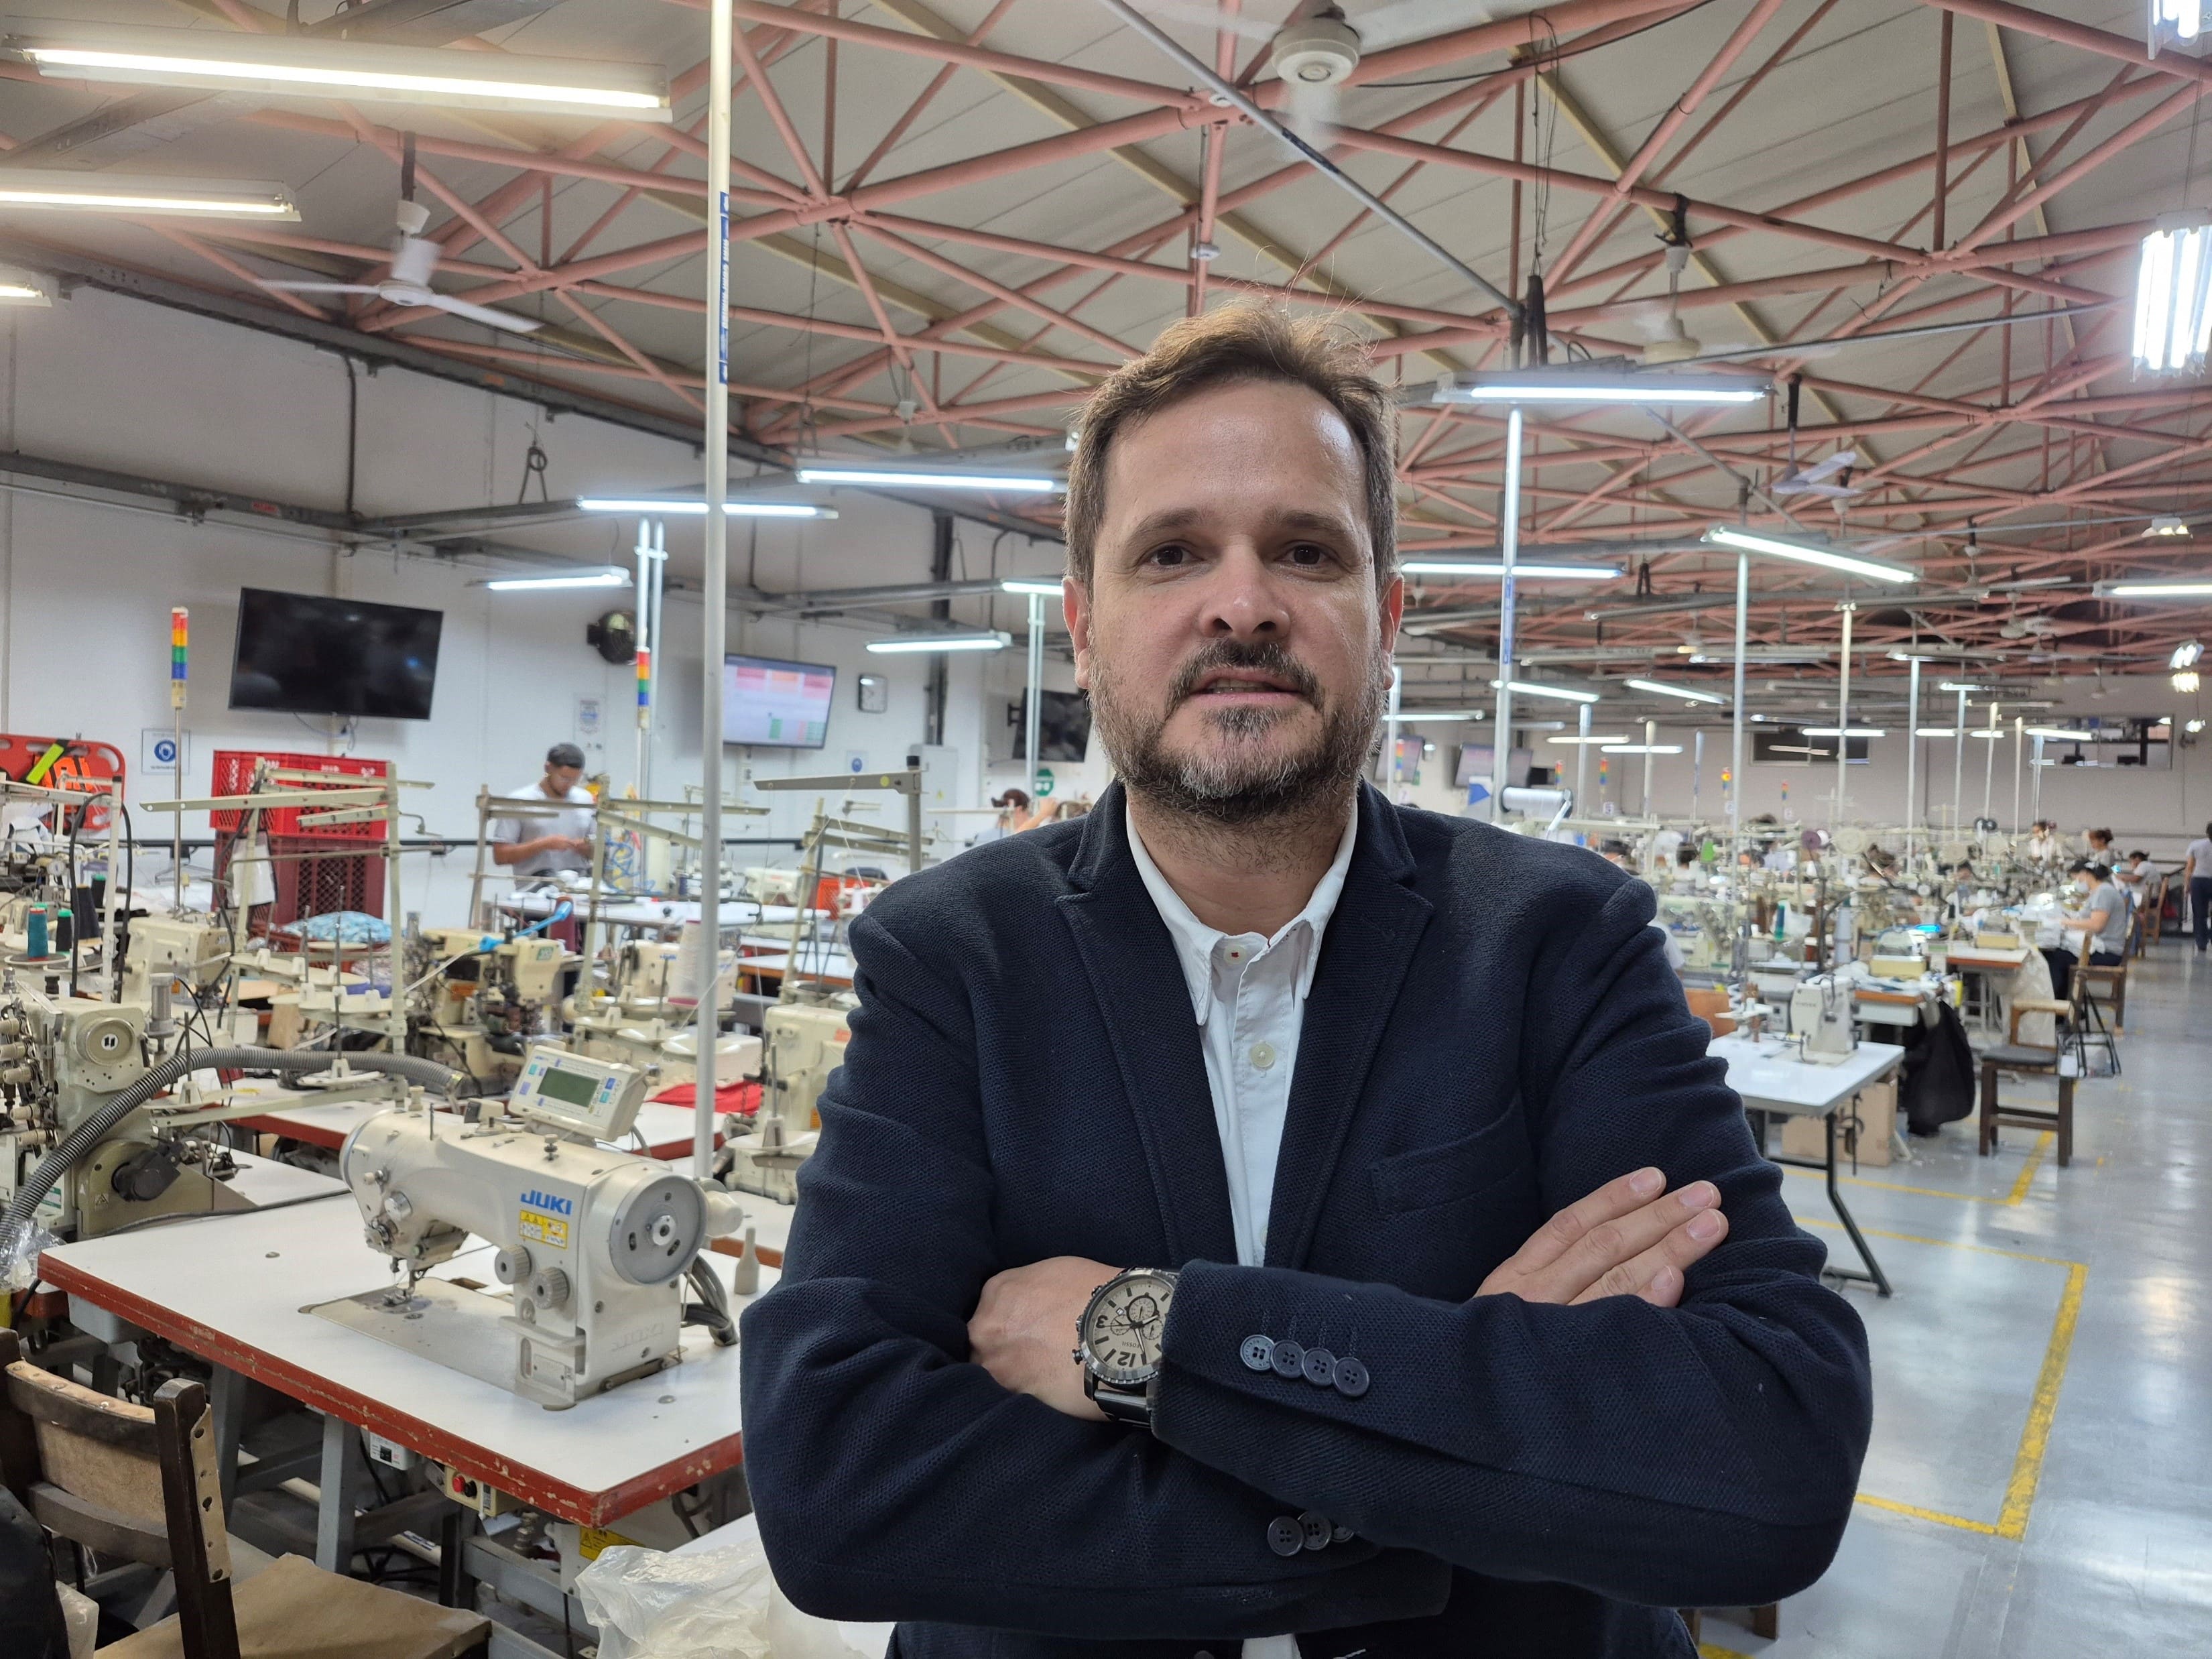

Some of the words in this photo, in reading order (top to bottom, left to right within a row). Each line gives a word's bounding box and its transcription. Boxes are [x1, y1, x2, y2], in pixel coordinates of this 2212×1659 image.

[520, 1190, 572, 1215] JUKI
[1095, 1315, 1108, 1329] 3
[1117, 1351, 1136, 1367] 12
